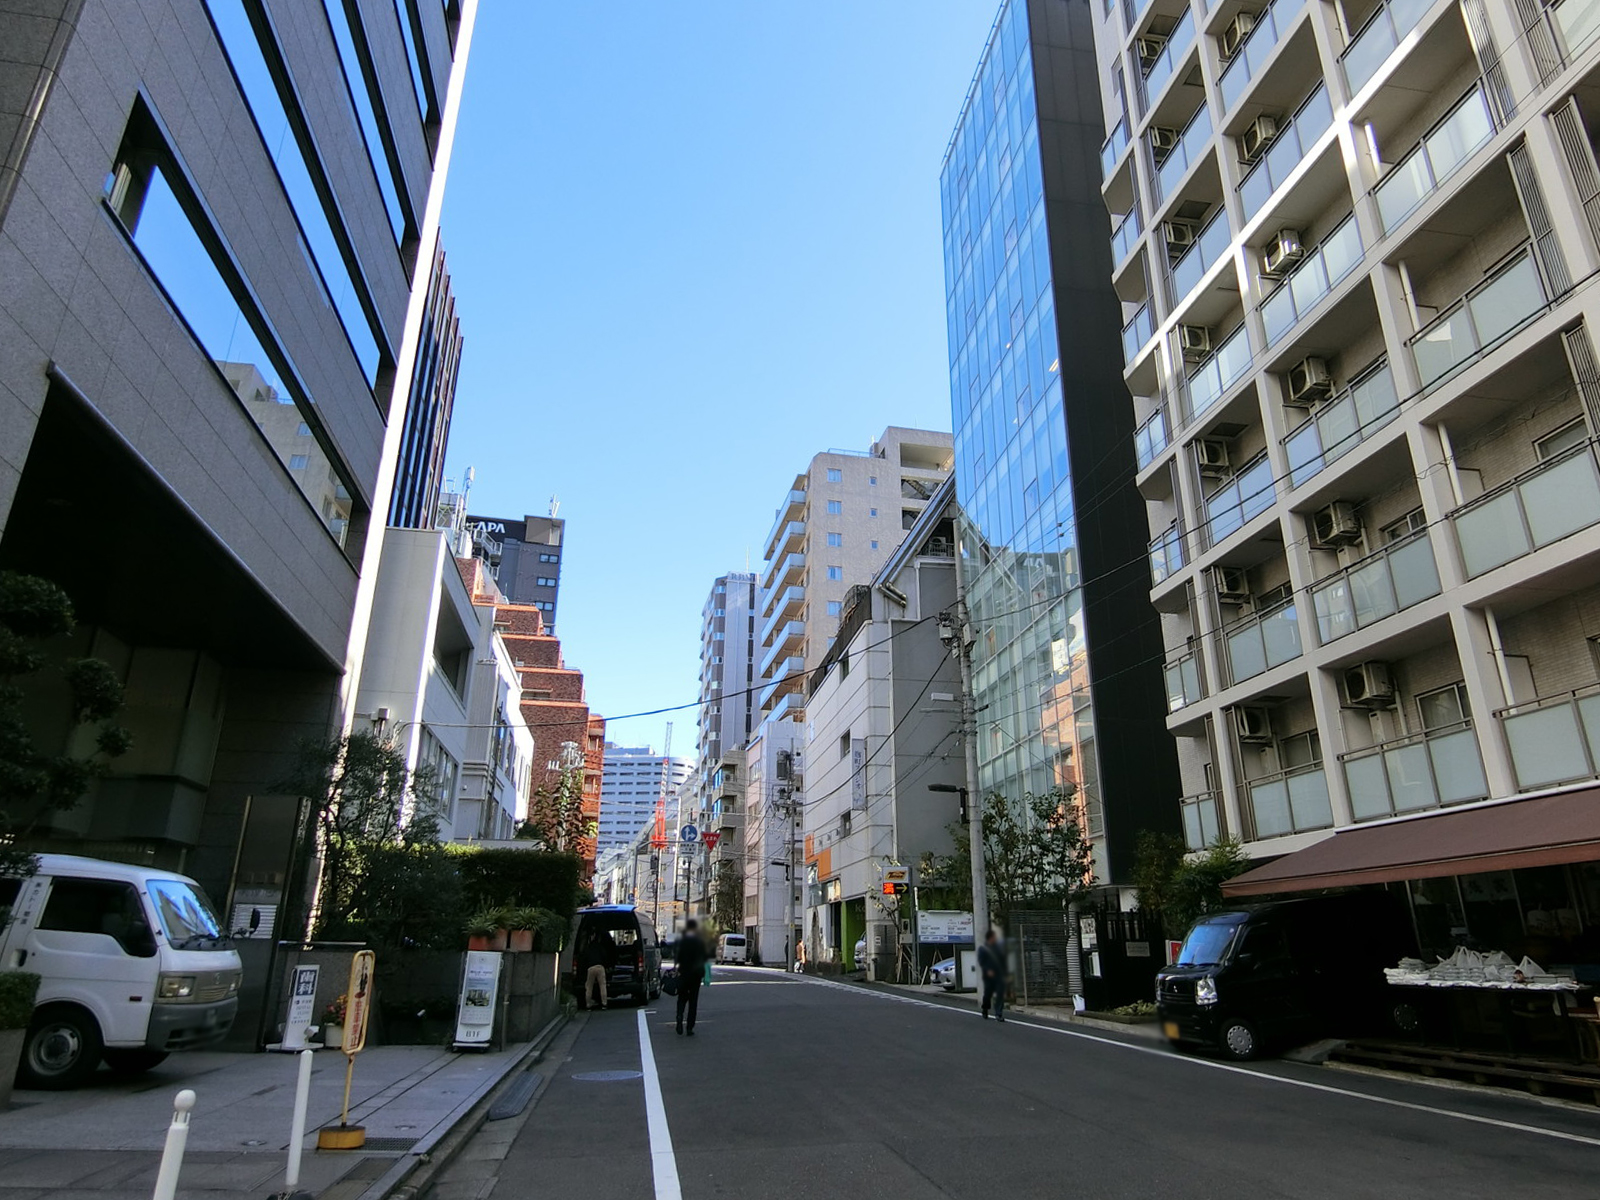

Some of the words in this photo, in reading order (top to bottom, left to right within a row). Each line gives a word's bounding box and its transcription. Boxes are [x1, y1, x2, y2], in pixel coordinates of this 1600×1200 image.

[477, 521, 506, 533] APA
[297, 970, 315, 995] 歯科
[465, 1030, 481, 1038] B1F
